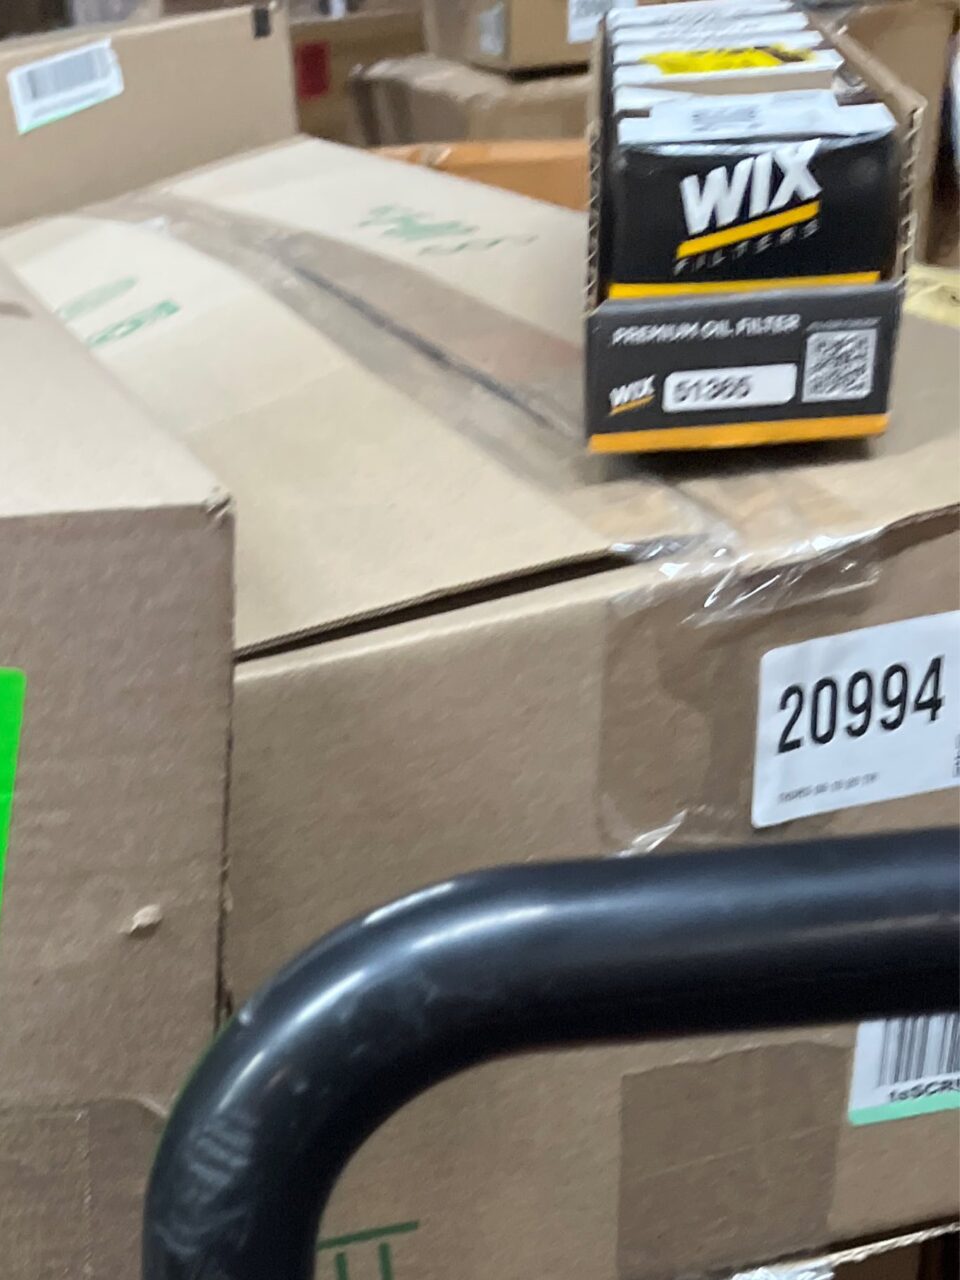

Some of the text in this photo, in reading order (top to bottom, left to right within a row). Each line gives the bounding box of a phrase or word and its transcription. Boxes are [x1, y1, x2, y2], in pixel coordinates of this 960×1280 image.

[679, 137, 823, 236] WIX
[610, 321, 701, 346] PREMIUM
[701, 319, 735, 341] OIL
[735, 313, 801, 337] FILTER
[608, 374, 657, 408] WIX
[775, 653, 947, 755] 20994
